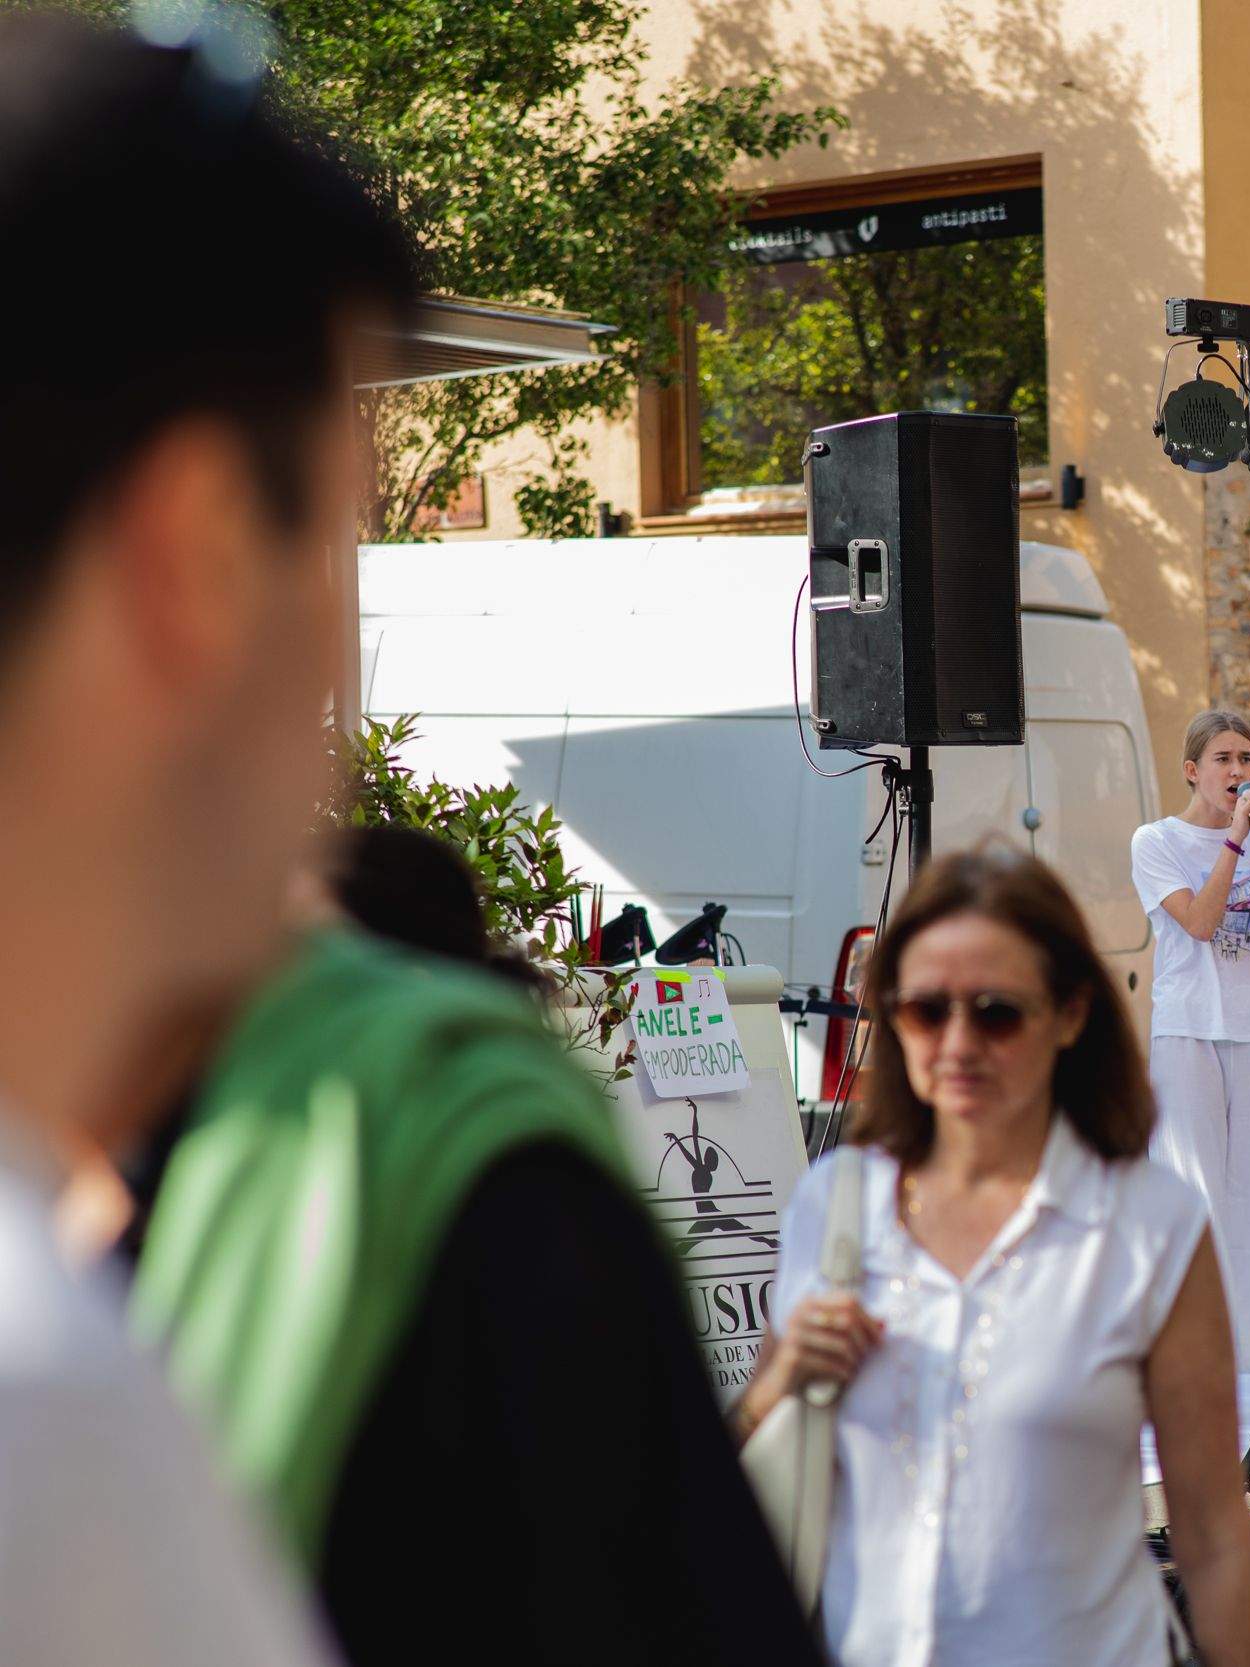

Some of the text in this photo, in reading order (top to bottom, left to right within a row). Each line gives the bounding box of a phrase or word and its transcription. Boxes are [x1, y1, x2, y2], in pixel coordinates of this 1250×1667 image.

[921, 202, 1008, 229] antipasti
[637, 1006, 702, 1037] ANELE
[643, 1038, 748, 1080] EMPODERADA
[724, 1346, 745, 1363] DE
